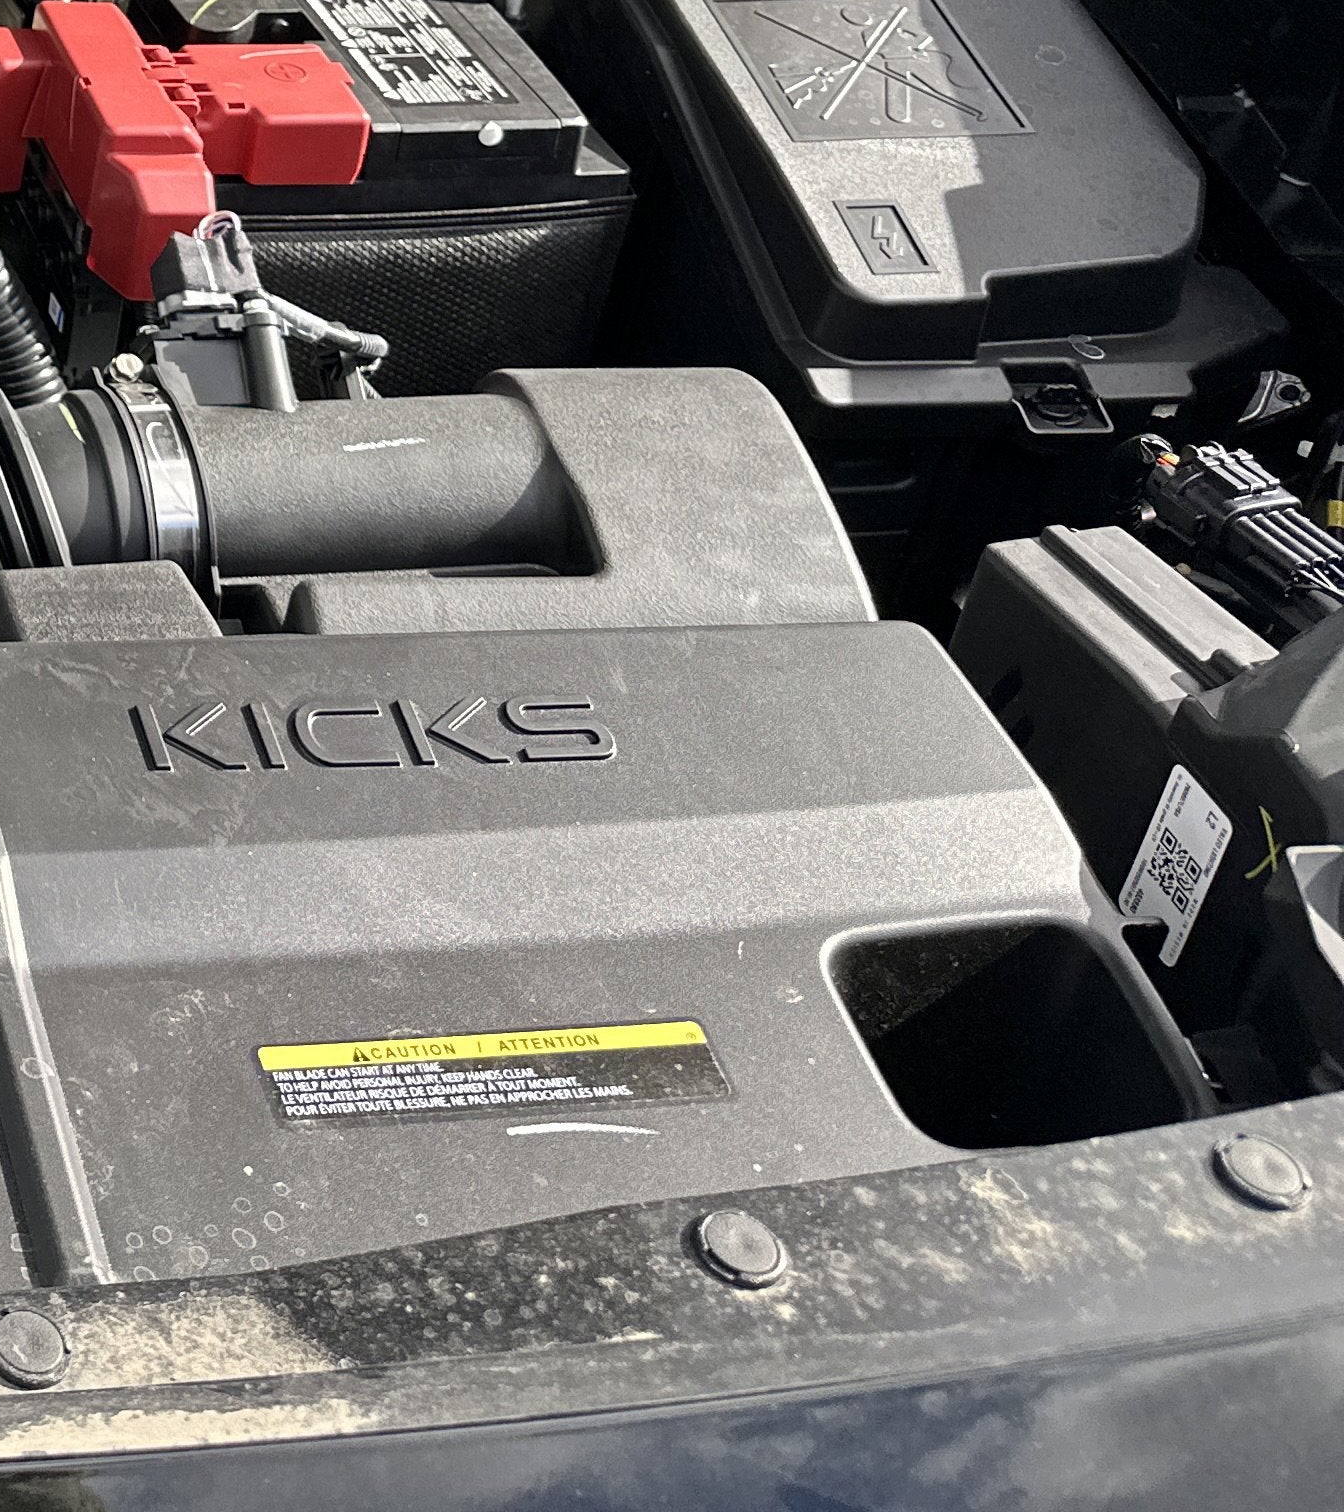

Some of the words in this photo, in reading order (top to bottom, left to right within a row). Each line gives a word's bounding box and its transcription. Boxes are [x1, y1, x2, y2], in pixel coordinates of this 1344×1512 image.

[127, 694, 618, 773] KICKS
[370, 1043, 456, 1059] CAUTION
[499, 1034, 600, 1052] ATTENTION
[329, 1068, 350, 1078] CAN
[351, 1066, 380, 1077] START
[381, 1065, 394, 1075] AT
[396, 1064, 416, 1074] ANY
